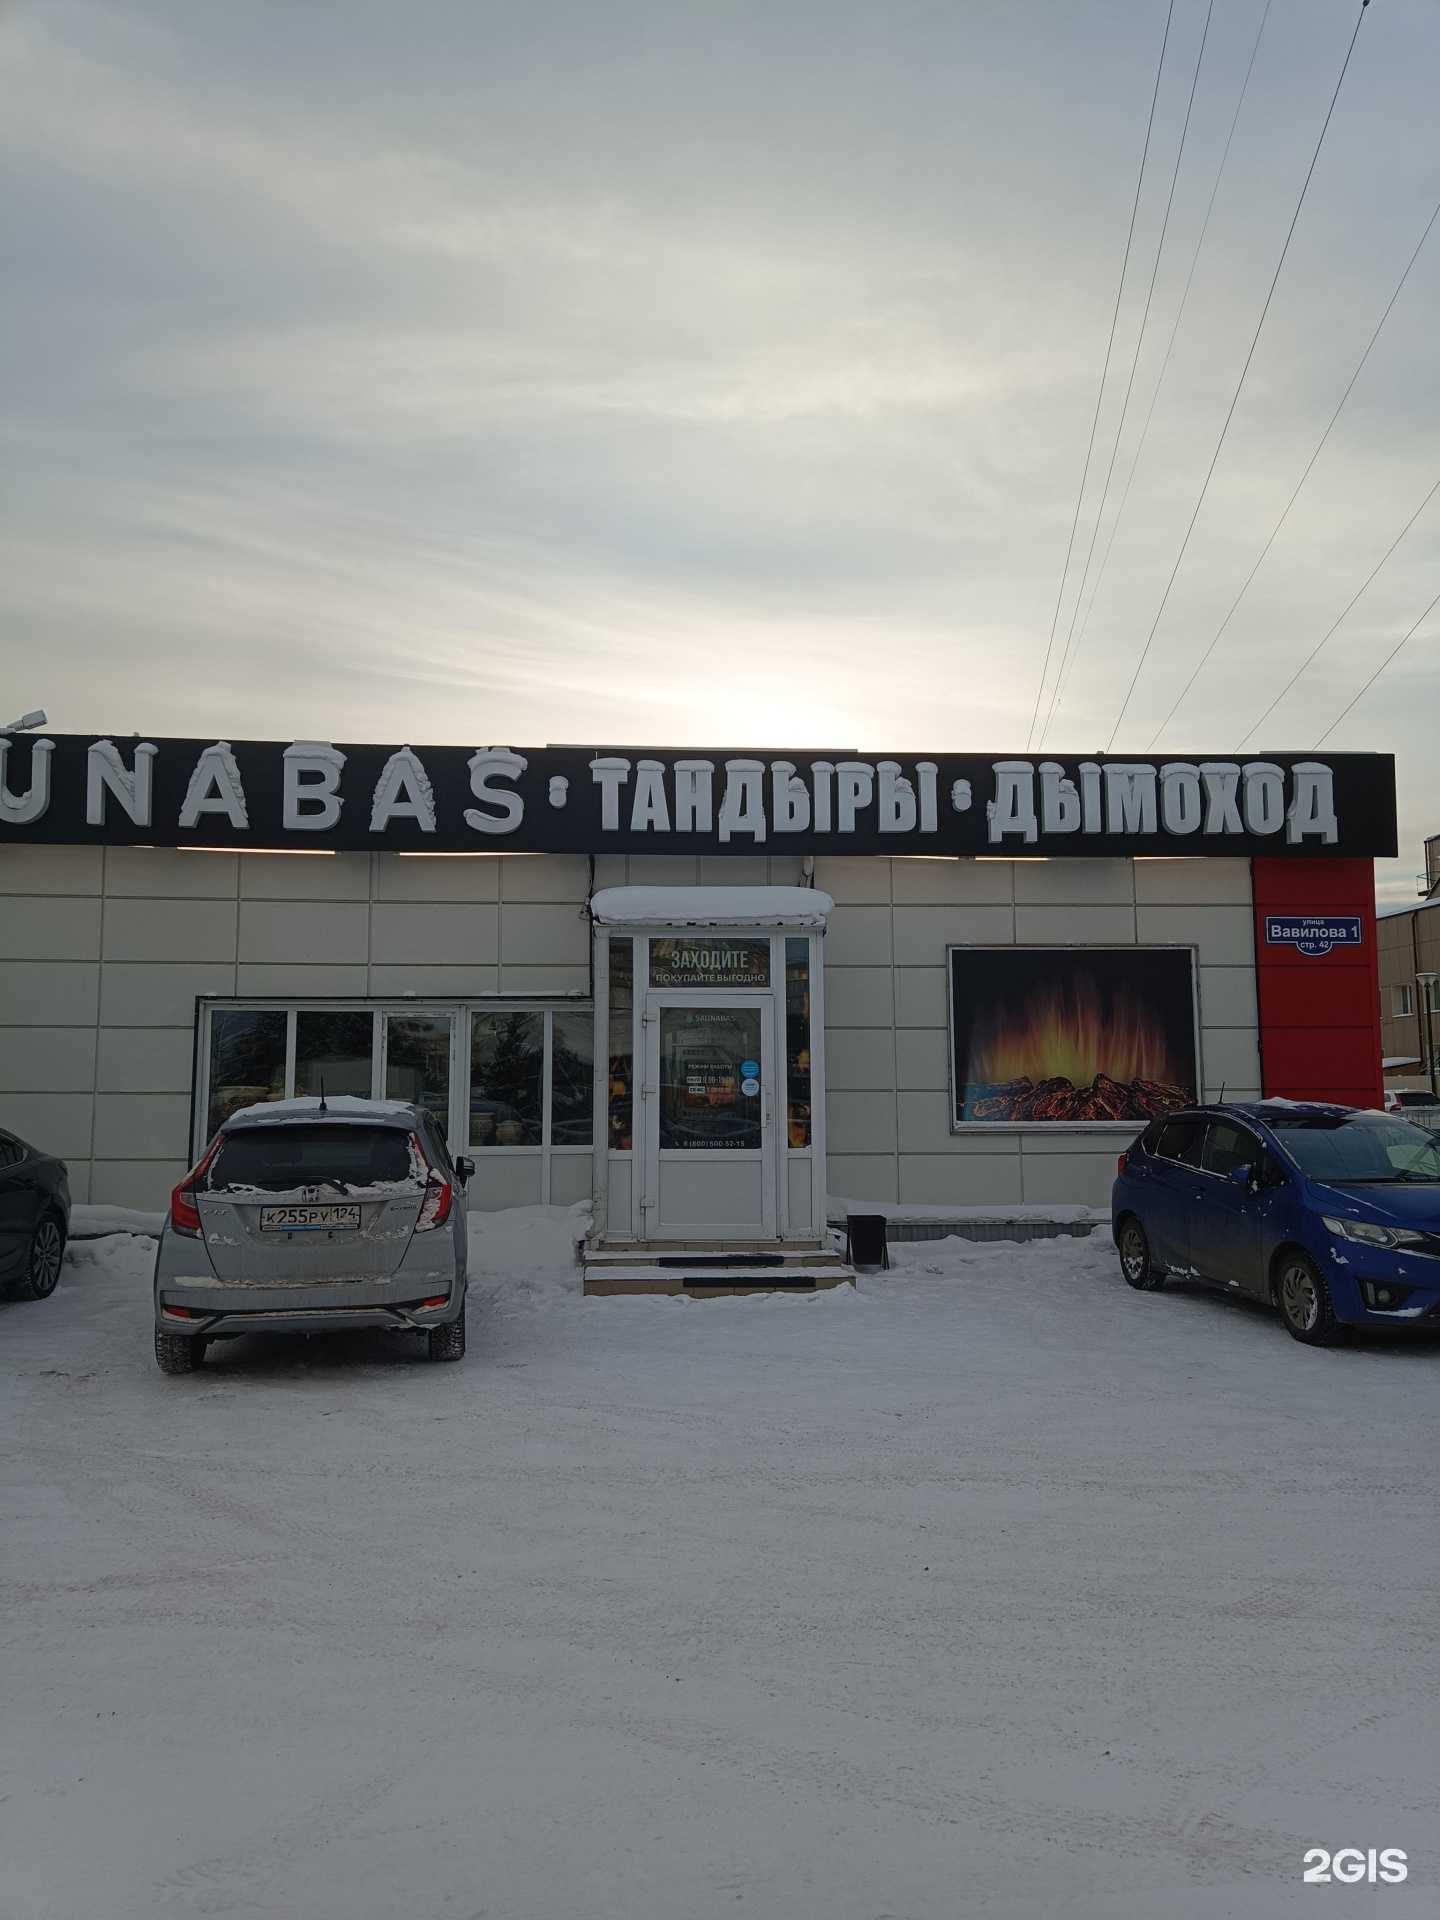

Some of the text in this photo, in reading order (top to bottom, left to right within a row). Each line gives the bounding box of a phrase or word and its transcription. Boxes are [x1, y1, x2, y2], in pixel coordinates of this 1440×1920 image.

[589, 758, 1338, 844] ТАНДЫРЫ ДЫМОХОД
[1271, 925, 1359, 938] Вавилова 1
[1300, 941, 1329, 950] стр. 42
[671, 950, 749, 970] ЗАХОДИТЕ
[655, 973, 766, 983] ПОКУПАЙТЕ ВЫГОДНО
